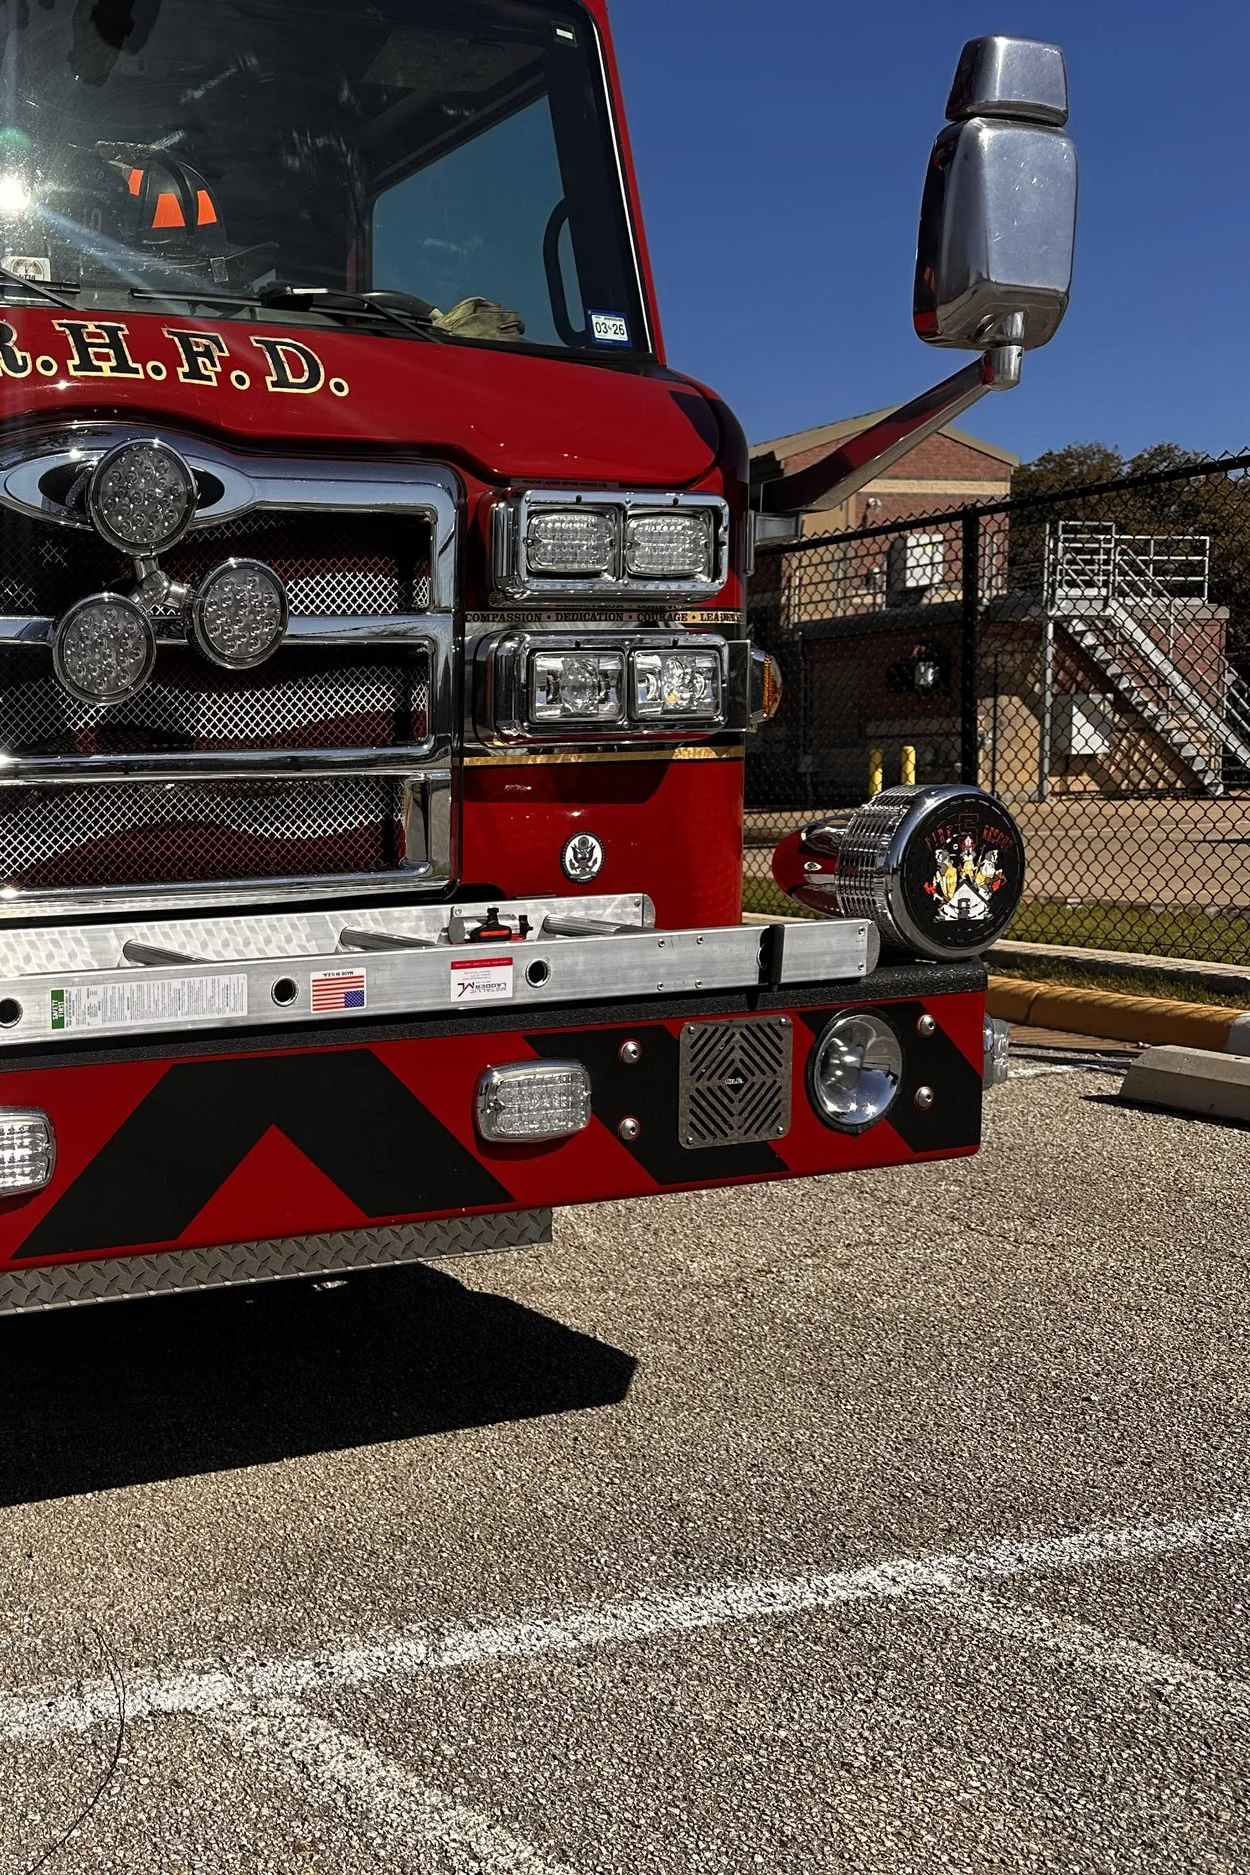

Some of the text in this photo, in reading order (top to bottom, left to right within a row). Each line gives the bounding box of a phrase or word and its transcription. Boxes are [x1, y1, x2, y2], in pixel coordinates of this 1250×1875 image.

[595, 321, 625, 335] 03 26
[465, 611, 542, 623] COMPASSION
[555, 611, 624, 622] DEDICATION
[636, 611, 688, 622] COURAGE
